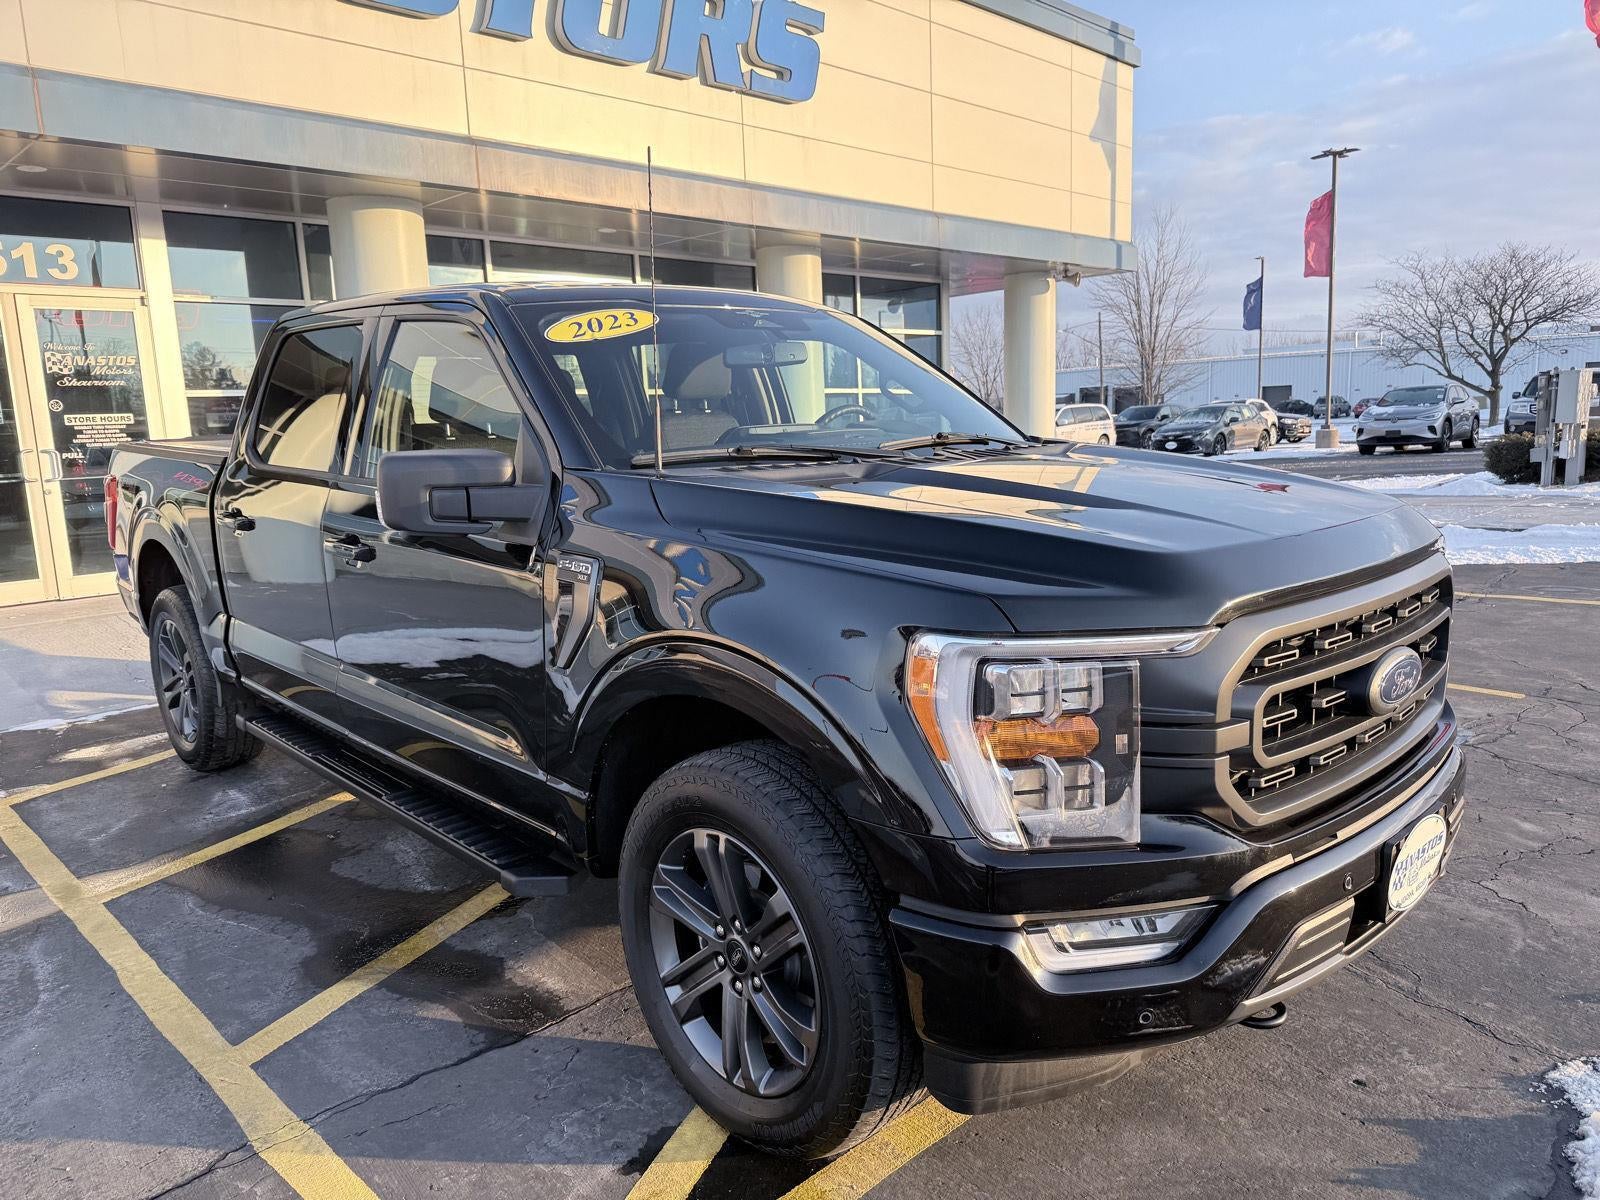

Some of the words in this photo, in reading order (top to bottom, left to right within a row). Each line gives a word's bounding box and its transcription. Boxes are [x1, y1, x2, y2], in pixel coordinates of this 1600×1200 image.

[0, 241, 79, 280] 13
[568, 311, 639, 339] 2023
[44, 342, 81, 351] Welcome
[83, 342, 96, 351] To
[60, 354, 137, 366] ANASTOS
[91, 365, 135, 375] Motors
[56, 376, 127, 387] Showroom
[66, 416, 98, 424] STORE
[100, 415, 132, 423] HOURS
[62, 452, 86, 460] PULL
[1391, 665, 1417, 699] Ford
